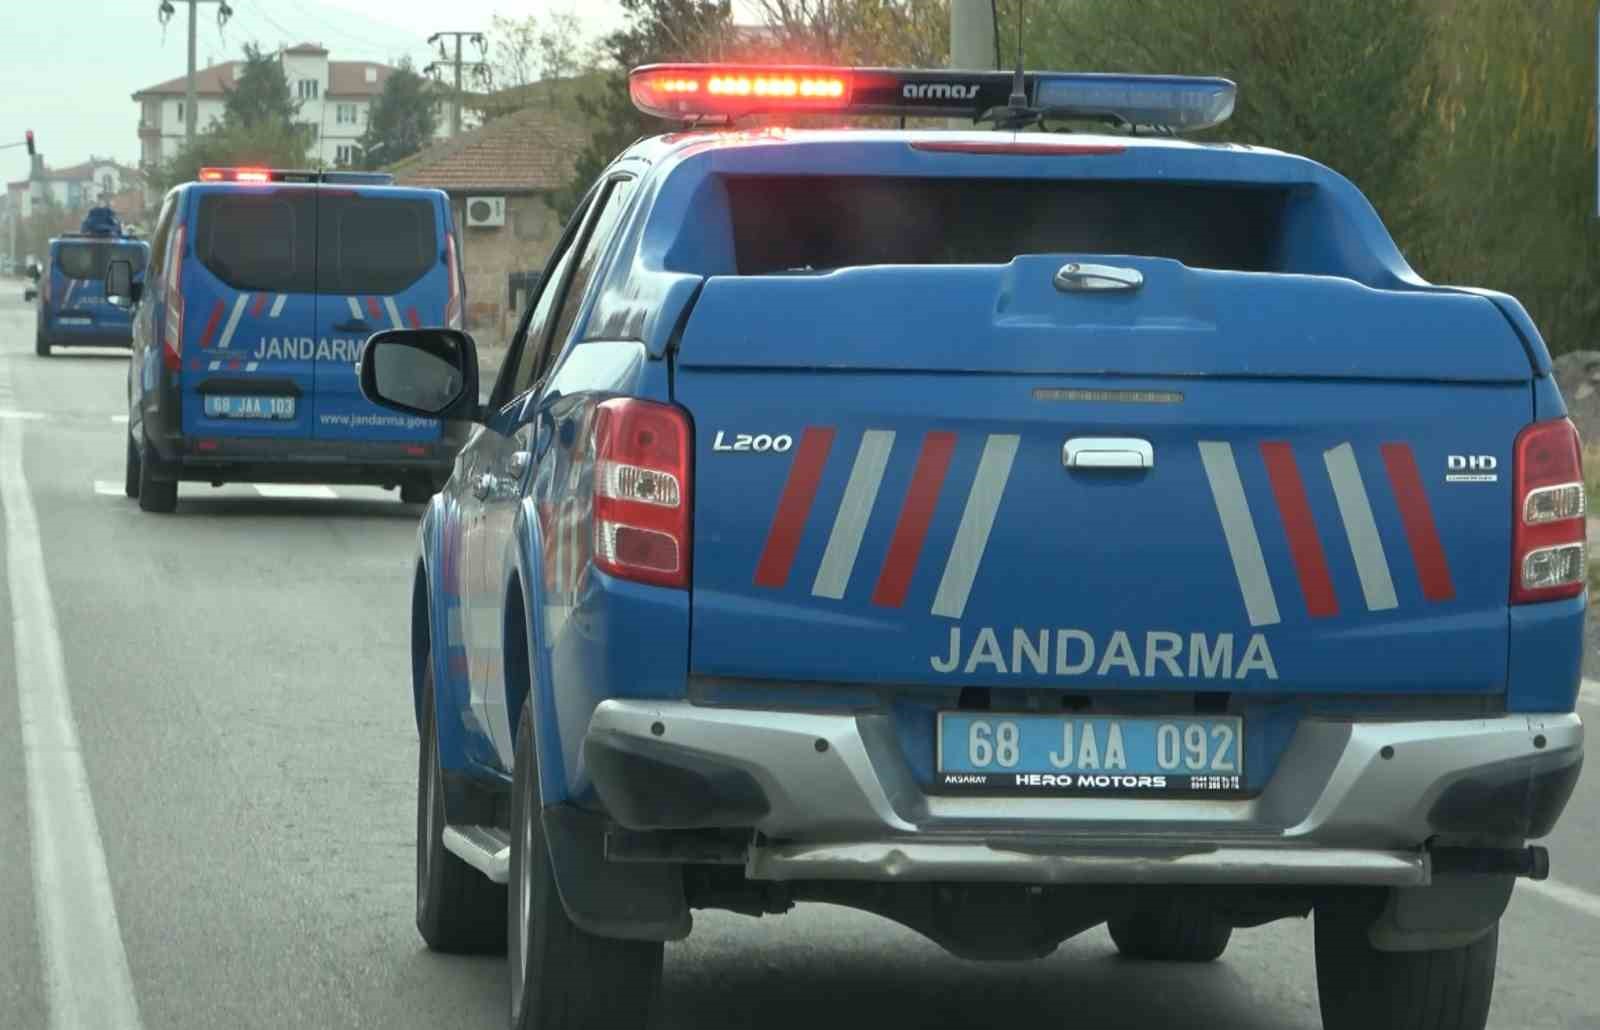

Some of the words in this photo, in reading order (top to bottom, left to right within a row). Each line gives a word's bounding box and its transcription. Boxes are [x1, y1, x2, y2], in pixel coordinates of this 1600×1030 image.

[903, 84, 980, 98] armas
[254, 337, 364, 361] JANDARM
[239, 397, 261, 413] JAA
[271, 397, 294, 414] 103
[713, 430, 793, 452] L200
[930, 627, 1279, 680] JANDARMA
[968, 720, 1020, 768] 68
[1049, 722, 1127, 770] JAA
[1157, 723, 1235, 771] 092
[1015, 774, 1072, 786] HERO
[1077, 775, 1167, 788] MOTORS
